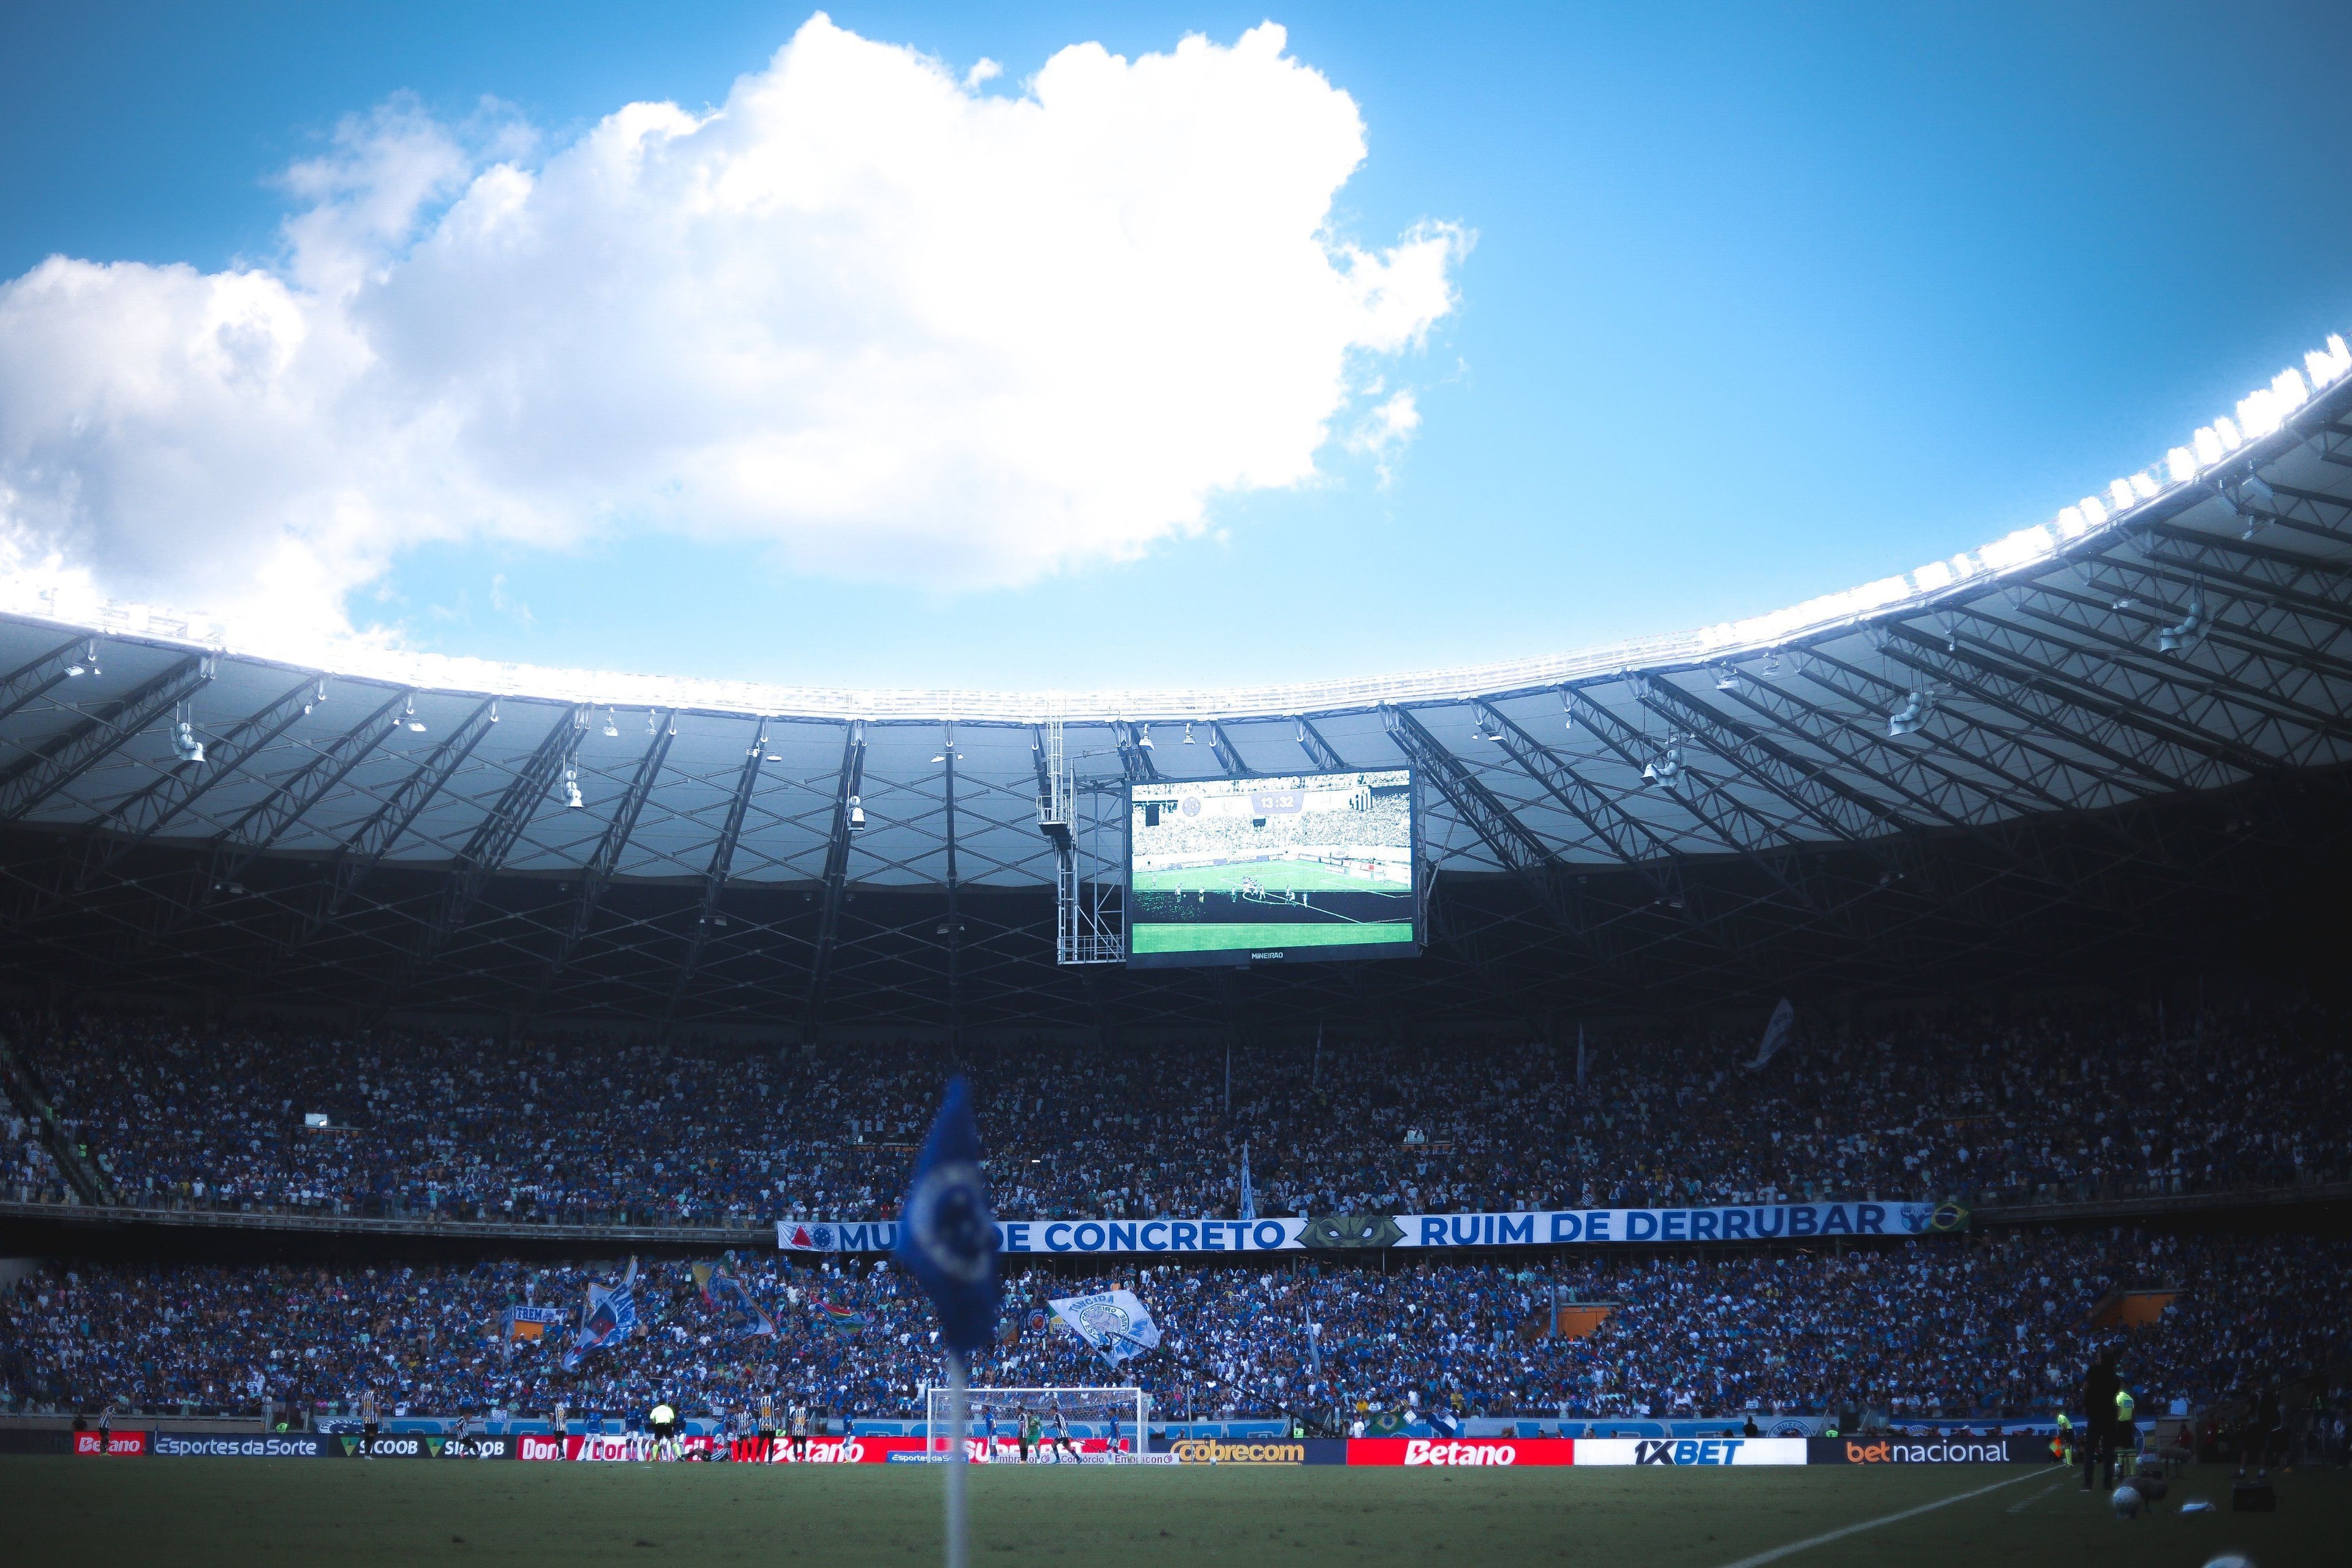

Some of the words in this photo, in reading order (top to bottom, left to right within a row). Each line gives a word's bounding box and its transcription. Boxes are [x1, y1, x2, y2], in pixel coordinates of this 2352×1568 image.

[1260, 796, 1294, 810] 13:32
[1045, 1218, 1286, 1252] CONCRETO
[1420, 1215, 1533, 1246] RUIM
[1551, 1212, 1610, 1243] DE
[1626, 1204, 1886, 1242] DERRUBAR
[517, 1307, 542, 1321] TREM
[1068, 1295, 1114, 1312] TORCIDA
[78, 1437, 140, 1452] Beano
[522, 1438, 567, 1460] Dorl
[1193, 1438, 1305, 1461] cobrecom
[1404, 1440, 1516, 1466] Betano
[1635, 1441, 1744, 1465] 1XBET
[1061, 1455, 1104, 1463] Conórcio
